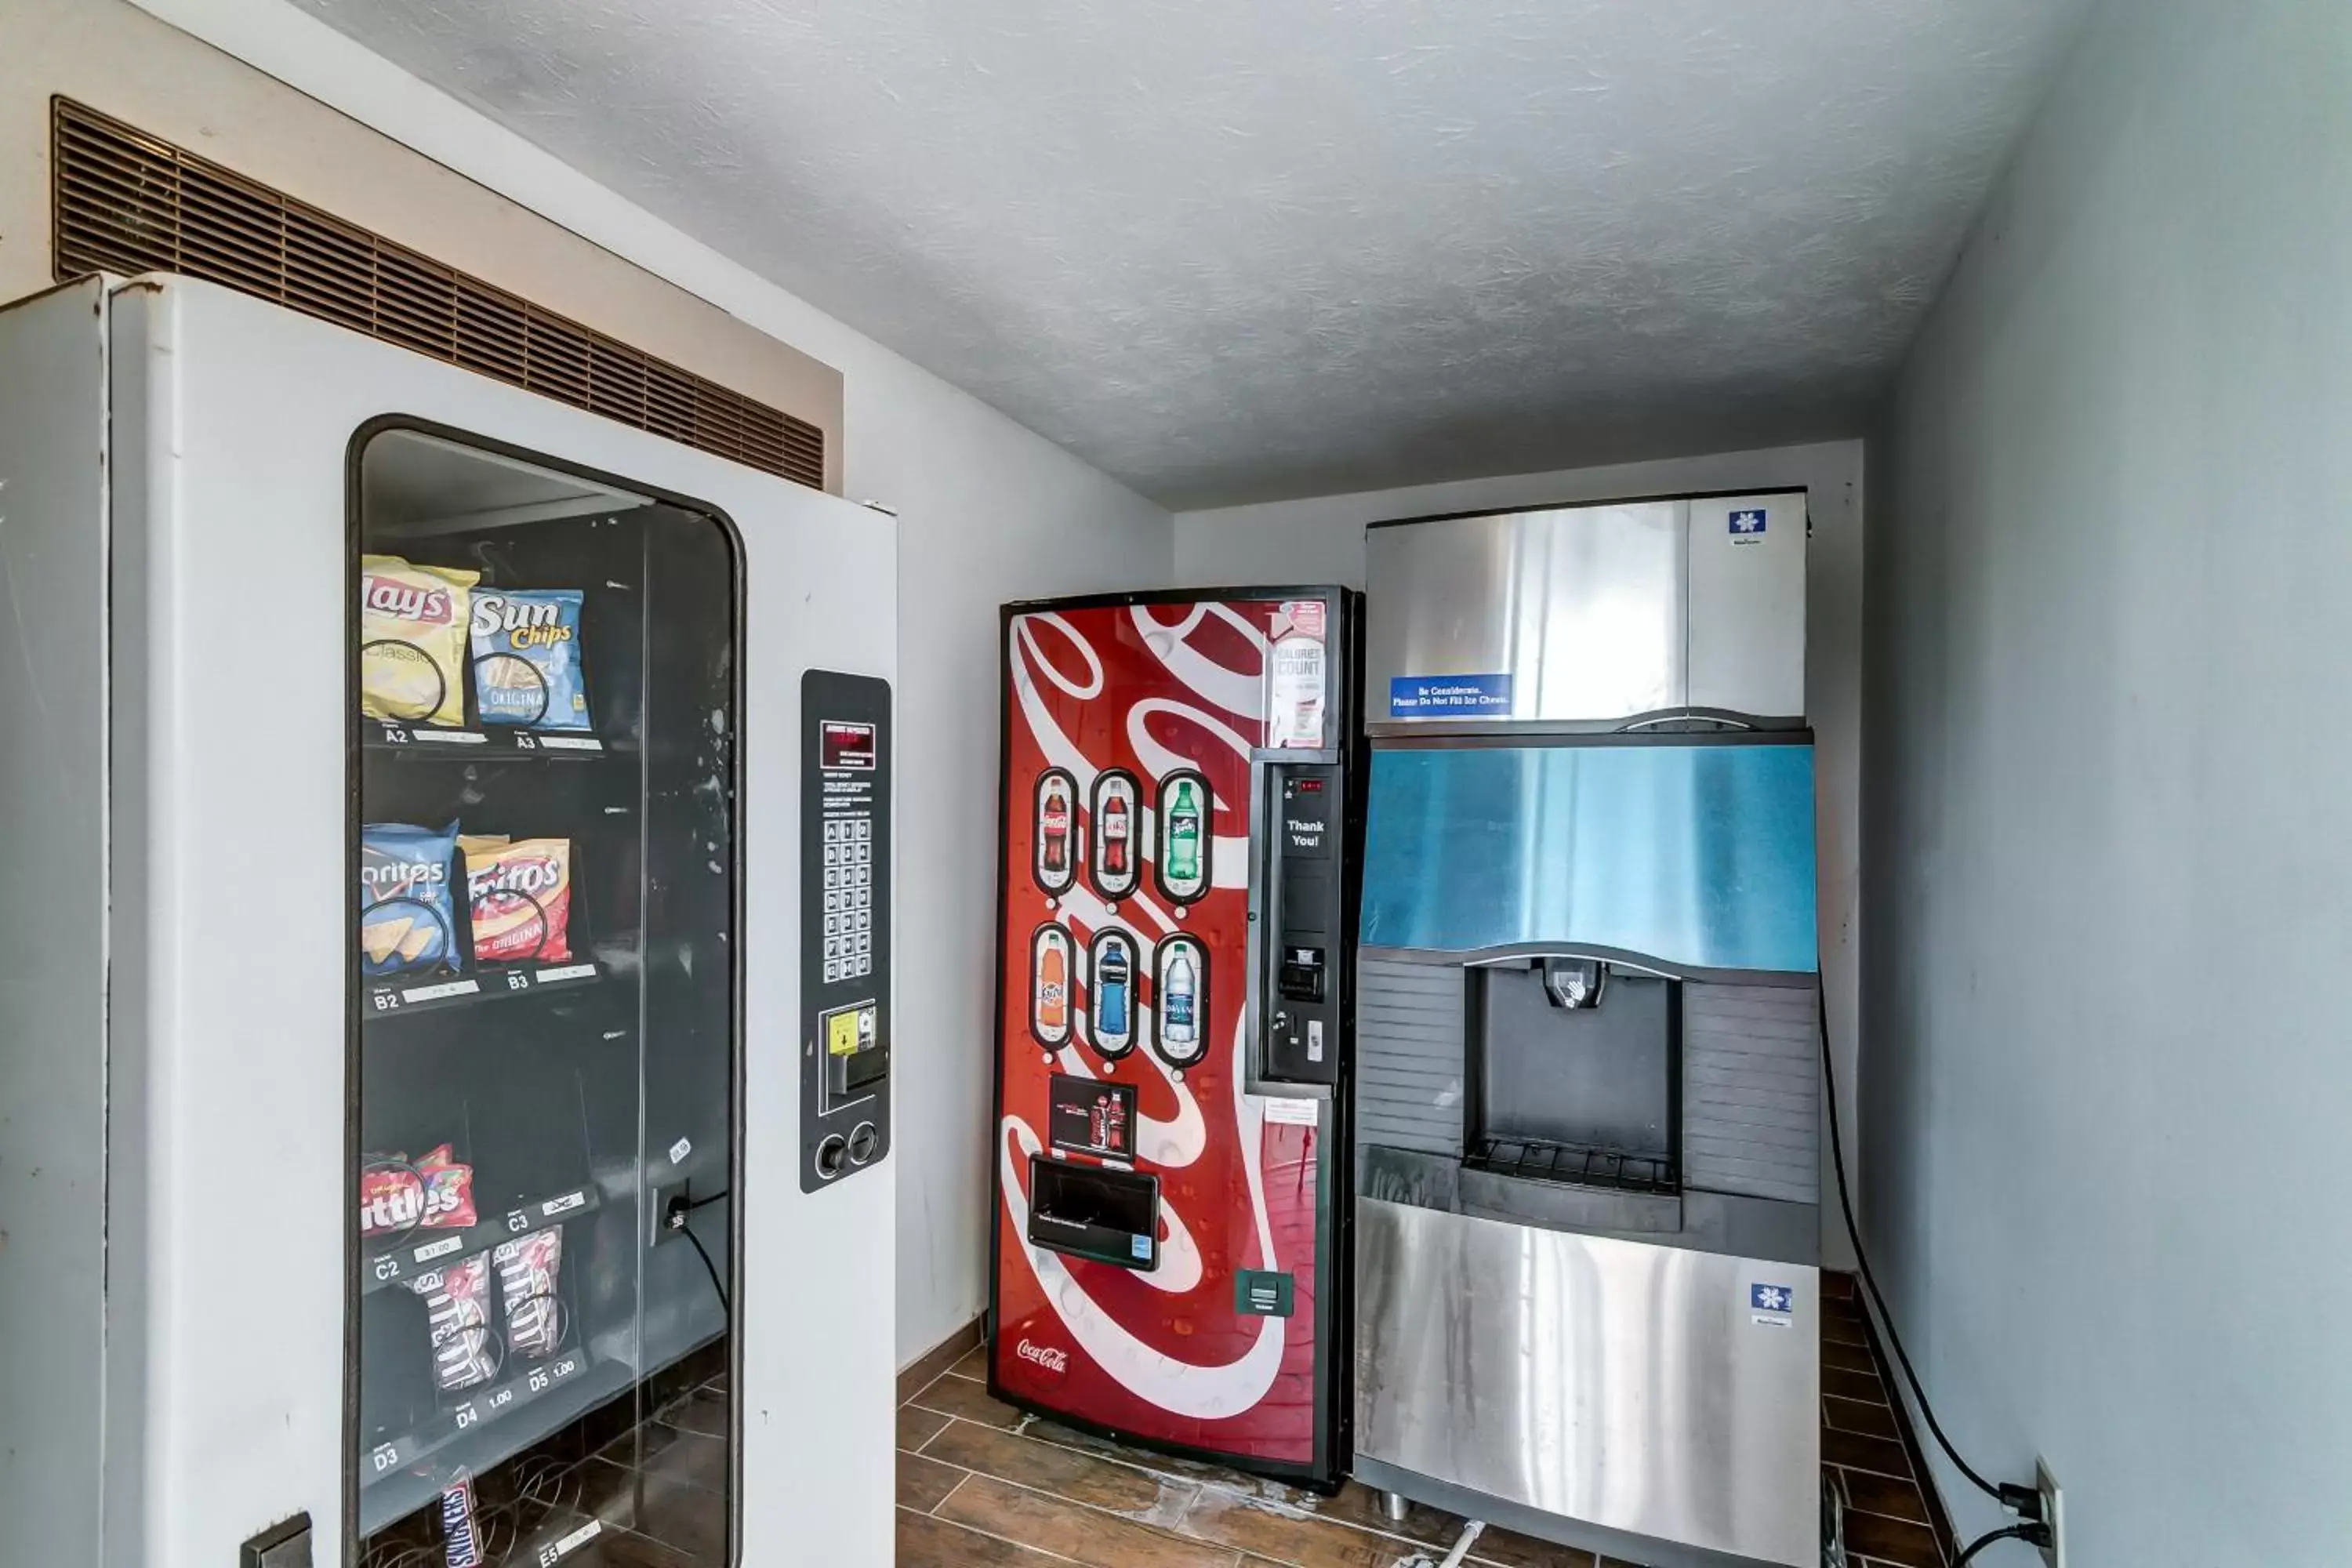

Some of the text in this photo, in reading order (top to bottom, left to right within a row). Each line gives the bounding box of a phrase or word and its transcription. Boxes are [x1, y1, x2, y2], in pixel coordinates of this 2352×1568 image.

[470, 596, 559, 637] Sun
[510, 625, 571, 650] Chips
[1279, 661, 1319, 675] COUNT
[492, 691, 544, 705] ORIGINA
[1418, 686, 1428, 695] Be
[1432, 696, 1447, 705] Not
[1465, 695, 1477, 705] Ice
[386, 730, 408, 742] A2
[517, 735, 535, 750] A3
[1287, 820, 1324, 832] Thank
[1293, 836, 1319, 847] You!
[362, 862, 443, 884] oritos
[492, 924, 543, 949] ORIGINA
[508, 975, 528, 989] B3
[374, 994, 399, 1011] B2
[361, 1186, 459, 1230] ittles
[509, 1215, 528, 1232] C3
[376, 1261, 400, 1280] C2
[529, 1372, 549, 1392] D5
[554, 1360, 575, 1377] 1.00
[456, 1407, 477, 1429] D4
[489, 1390, 512, 1408] 1.00
[374, 1448, 398, 1472] D3
[539, 1547, 557, 1568] E5
